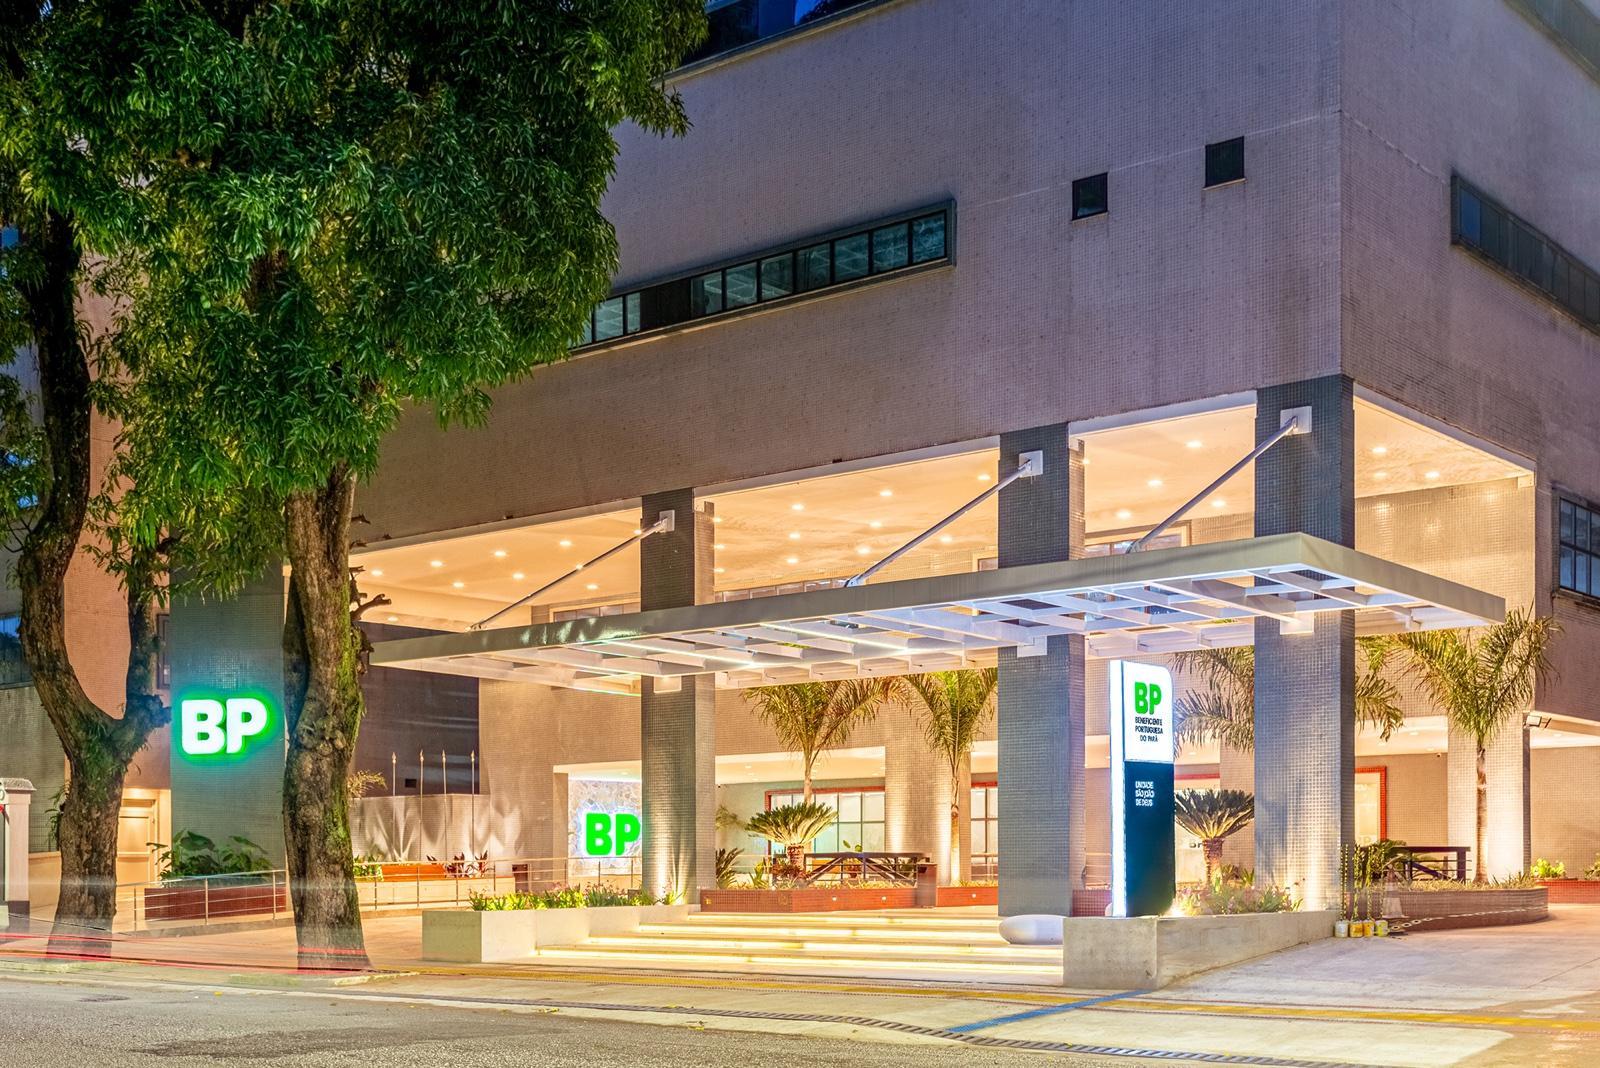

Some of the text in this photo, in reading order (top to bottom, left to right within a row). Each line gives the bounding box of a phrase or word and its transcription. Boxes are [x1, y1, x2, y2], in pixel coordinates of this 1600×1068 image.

[1134, 681, 1162, 715] BP
[181, 698, 268, 755] BP
[1135, 716, 1163, 726] BENEFICENTE
[1135, 725, 1163, 734] PORTUGUESA
[585, 812, 641, 856] BP
